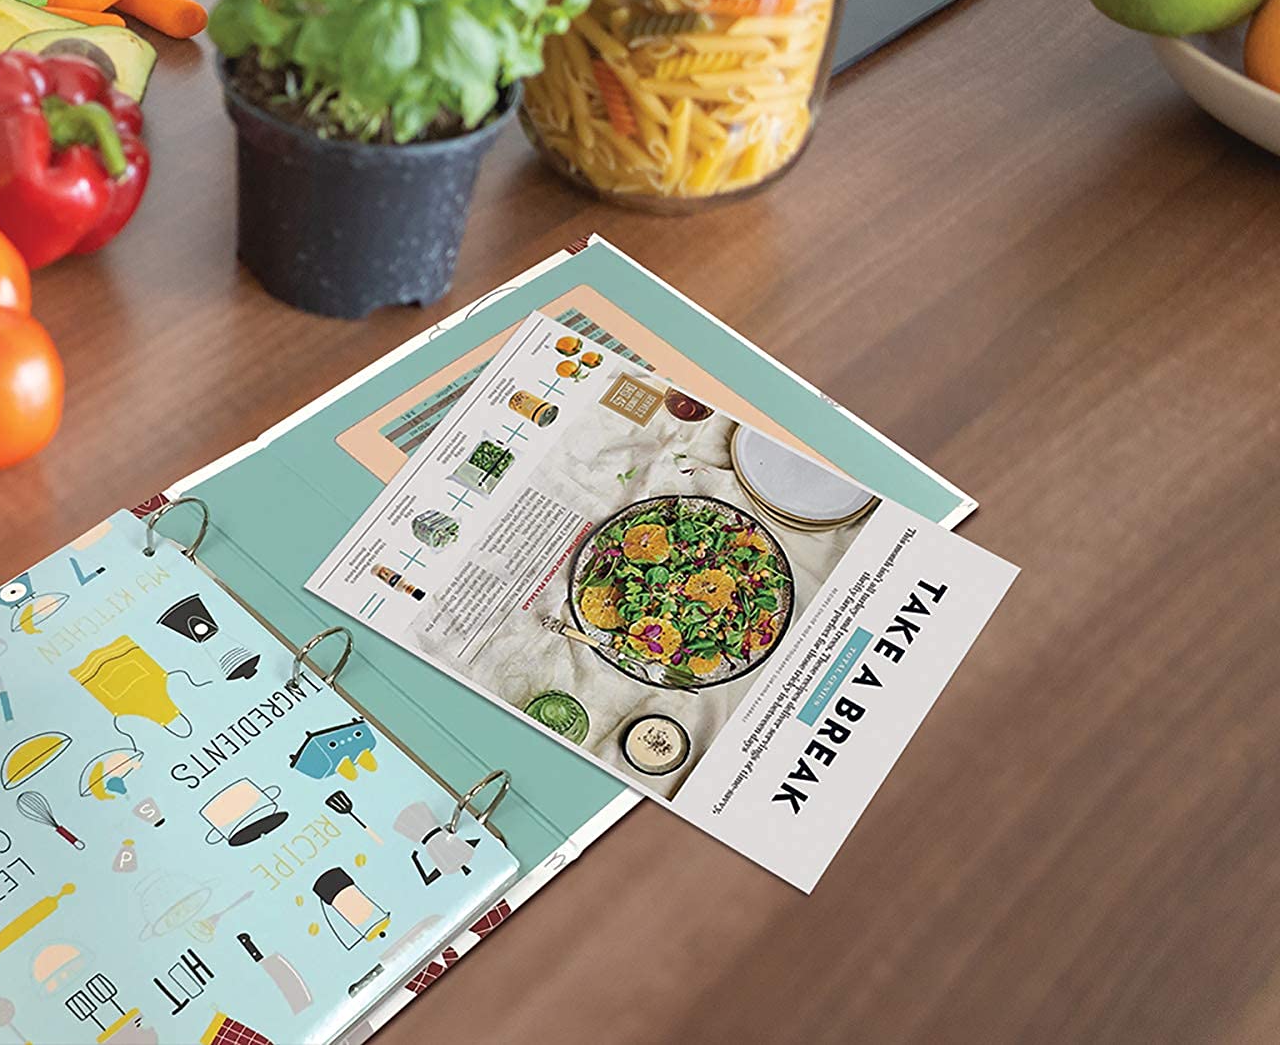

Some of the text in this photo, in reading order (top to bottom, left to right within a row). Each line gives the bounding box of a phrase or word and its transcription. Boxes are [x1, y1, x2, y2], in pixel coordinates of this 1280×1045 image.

[898, 526, 916, 546] This
[882, 543, 905, 568] month
[847, 569, 872, 597] thrifty
[865, 581, 879, 594] all
[34, 564, 172, 665] MY KITCHEN
[838, 595, 855, 613] fare
[847, 590, 872, 617] turkey
[818, 610, 844, 639] perfect
[838, 615, 855, 632] and
[811, 636, 827, 651] for
[824, 630, 845, 653] trees.
[797, 648, 818, 671] those
[808, 651, 831, 676] These
[780, 667, 804, 694] tricky
[788, 672, 815, 703] recipes
[811, 645, 857, 707] TOTAL GENIUS
[772, 580, 947, 813] TAKE A BREAK
[771, 700, 796, 730] deliver
[168, 671, 324, 791] INGREDIENTS
[738, 731, 760, 754] days
[747, 726, 778, 763] servings
[249, 813, 343, 891] RECIPE
[153, 948, 214, 1014] HOT
